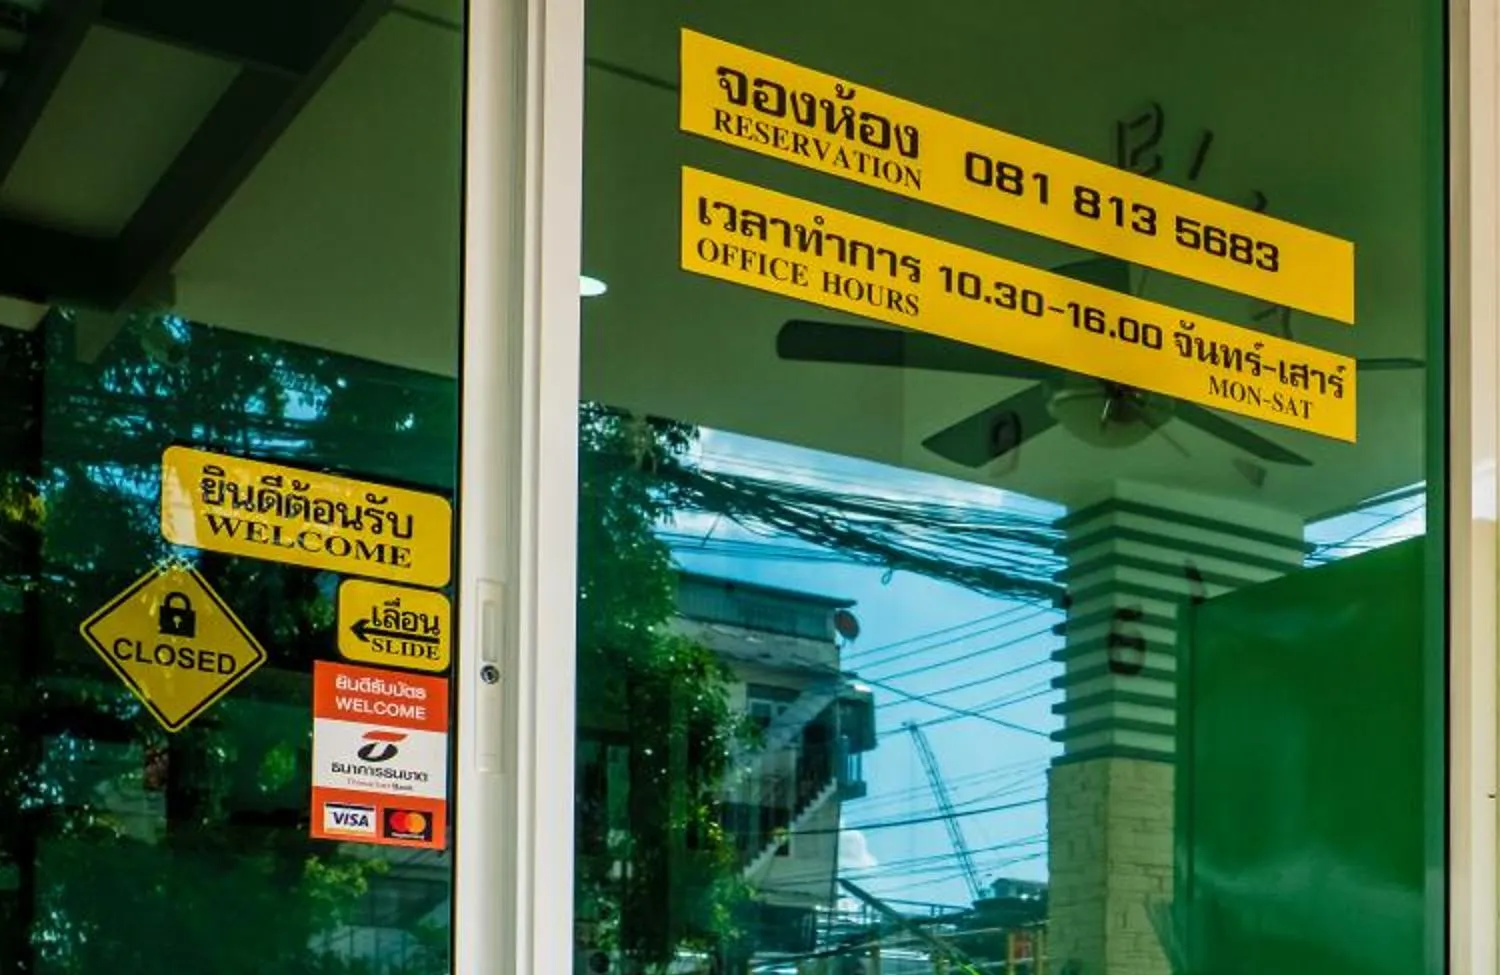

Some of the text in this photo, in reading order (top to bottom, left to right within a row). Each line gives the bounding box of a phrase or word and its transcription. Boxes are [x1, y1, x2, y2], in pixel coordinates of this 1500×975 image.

[716, 65, 920, 159] จองห้อง
[712, 108, 923, 191] RESERVATION
[964, 151, 1280, 273] 081 813 5683
[697, 237, 919, 317] OFFICE HOURS
[697, 196, 1347, 399] เวลาทำการ 10.30-16.00 จันทร์-เสาร์
[1208, 375, 1313, 420] MON-SAT
[200, 464, 414, 541] ยินดีต้อนรับ
[203, 513, 413, 569] WELCOME
[372, 597, 440, 636] เลื่อน
[112, 637, 237, 676] CLOSED
[372, 638, 440, 661] SLIDE
[335, 696, 427, 720] WELCOME
[333, 811, 369, 827] VISA
